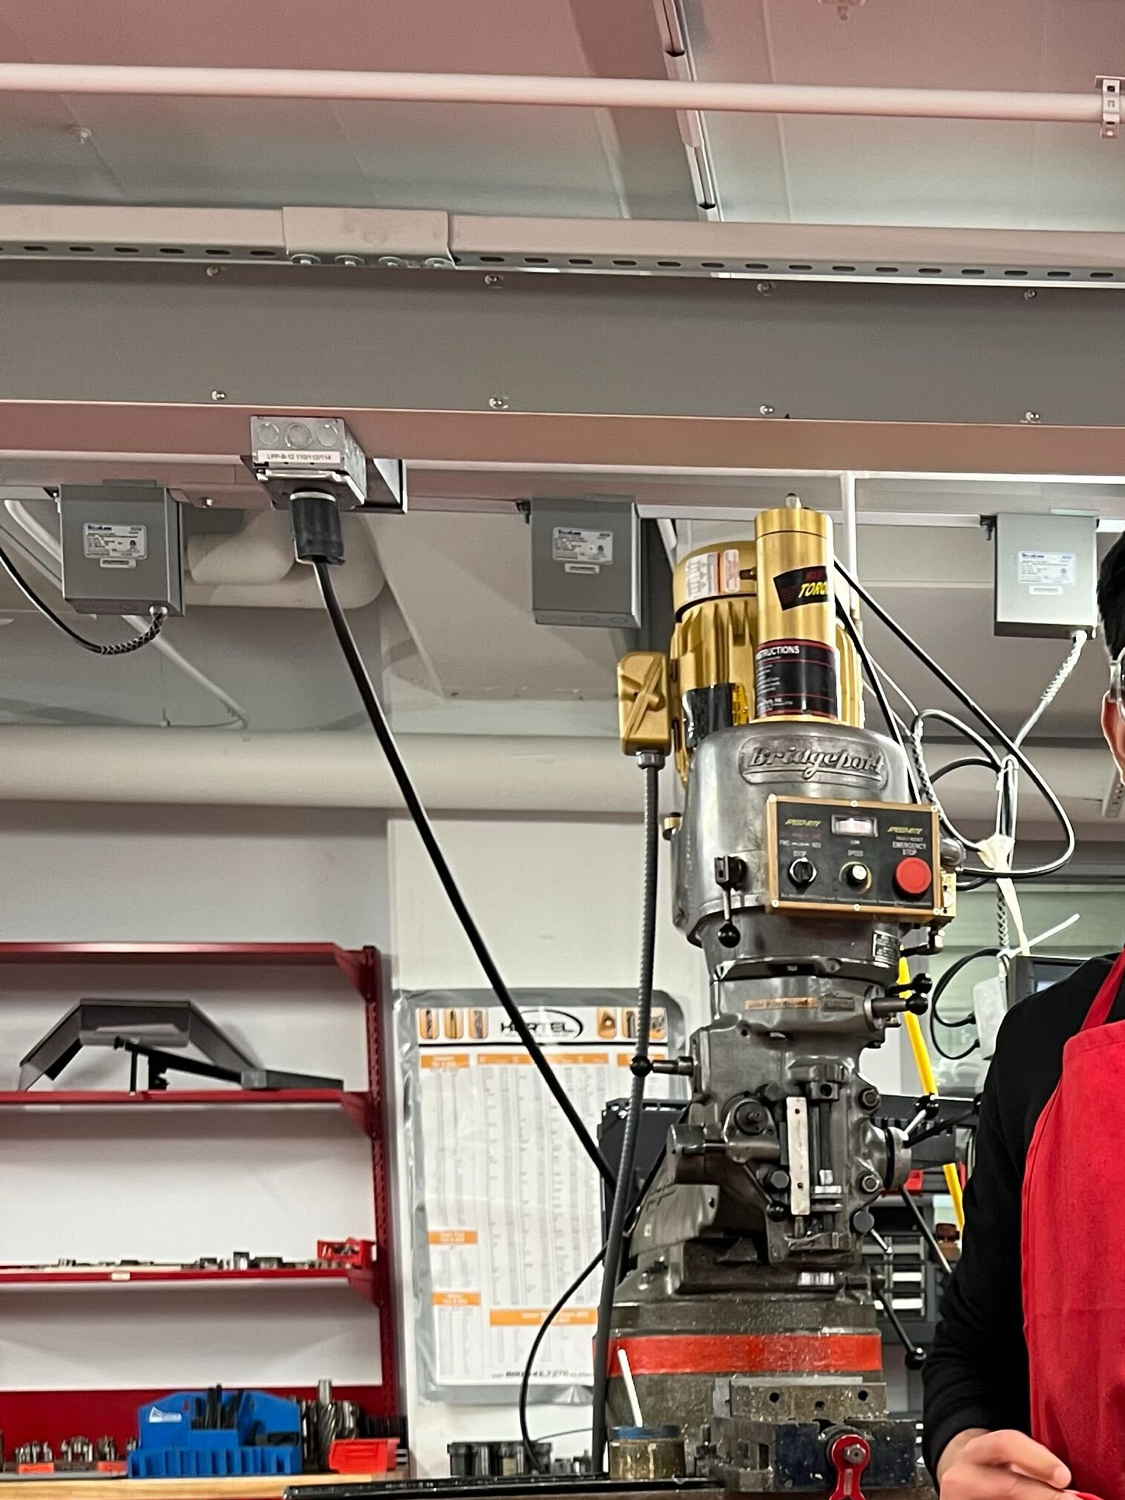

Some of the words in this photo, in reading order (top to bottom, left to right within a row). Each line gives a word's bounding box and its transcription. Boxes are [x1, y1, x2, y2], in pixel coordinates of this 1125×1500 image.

[747, 746, 886, 780] Bridgeport
[892, 841, 927, 850] EMERGENCY
[500, 1022, 576, 1034] HRTEL
